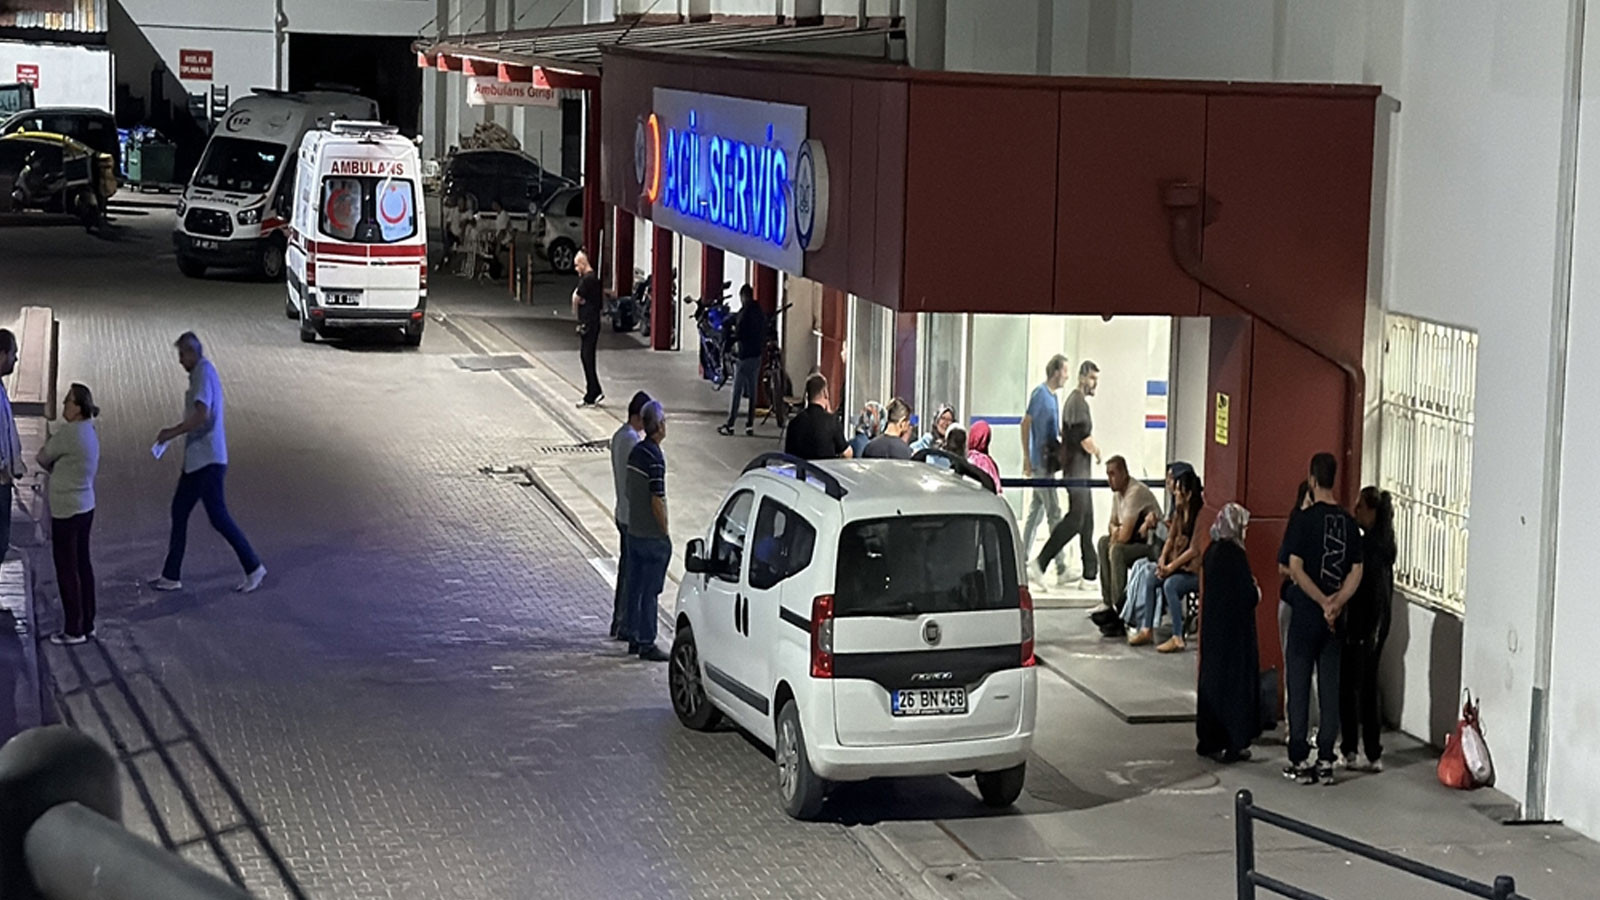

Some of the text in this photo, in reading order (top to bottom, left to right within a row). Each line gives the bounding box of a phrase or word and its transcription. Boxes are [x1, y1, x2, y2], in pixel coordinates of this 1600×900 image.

[474, 83, 525, 97] Ambulans
[331, 160, 404, 176] AMBULANS
[664, 109, 788, 246] ACİL SERVİS
[900, 690, 964, 708] 26 BN 468
